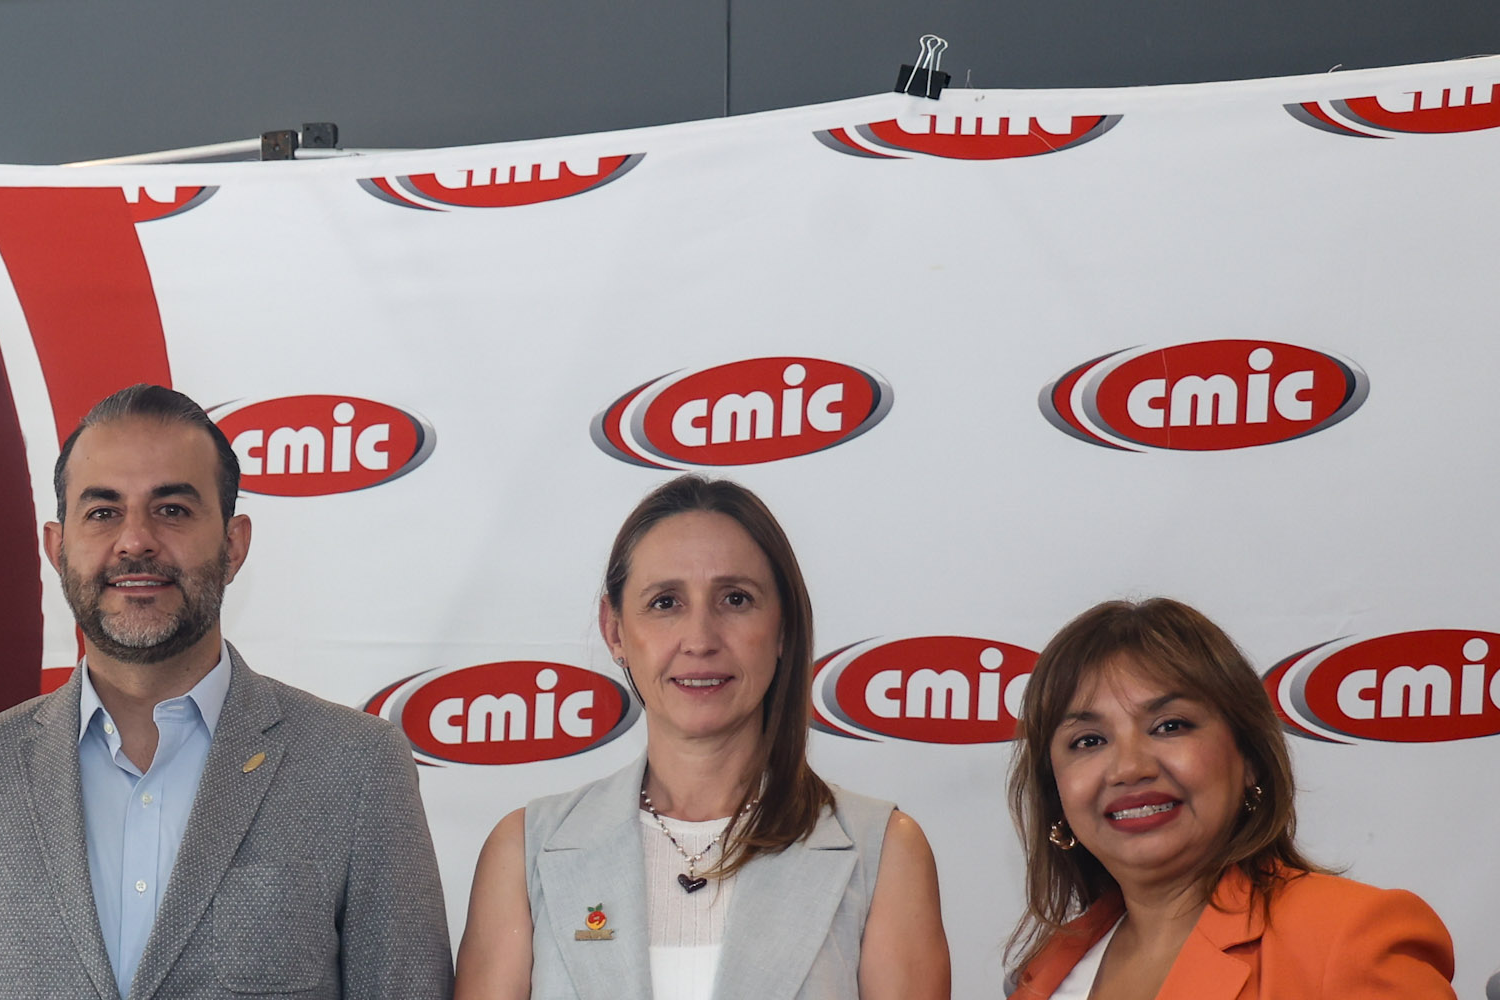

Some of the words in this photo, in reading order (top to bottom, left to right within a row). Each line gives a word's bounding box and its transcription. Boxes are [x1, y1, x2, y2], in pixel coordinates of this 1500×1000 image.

[671, 363, 844, 447] cmic
[1127, 347, 1314, 428] cmic
[231, 402, 390, 476] cmic
[429, 668, 594, 745] cmic
[1336, 637, 1500, 720] cmi
